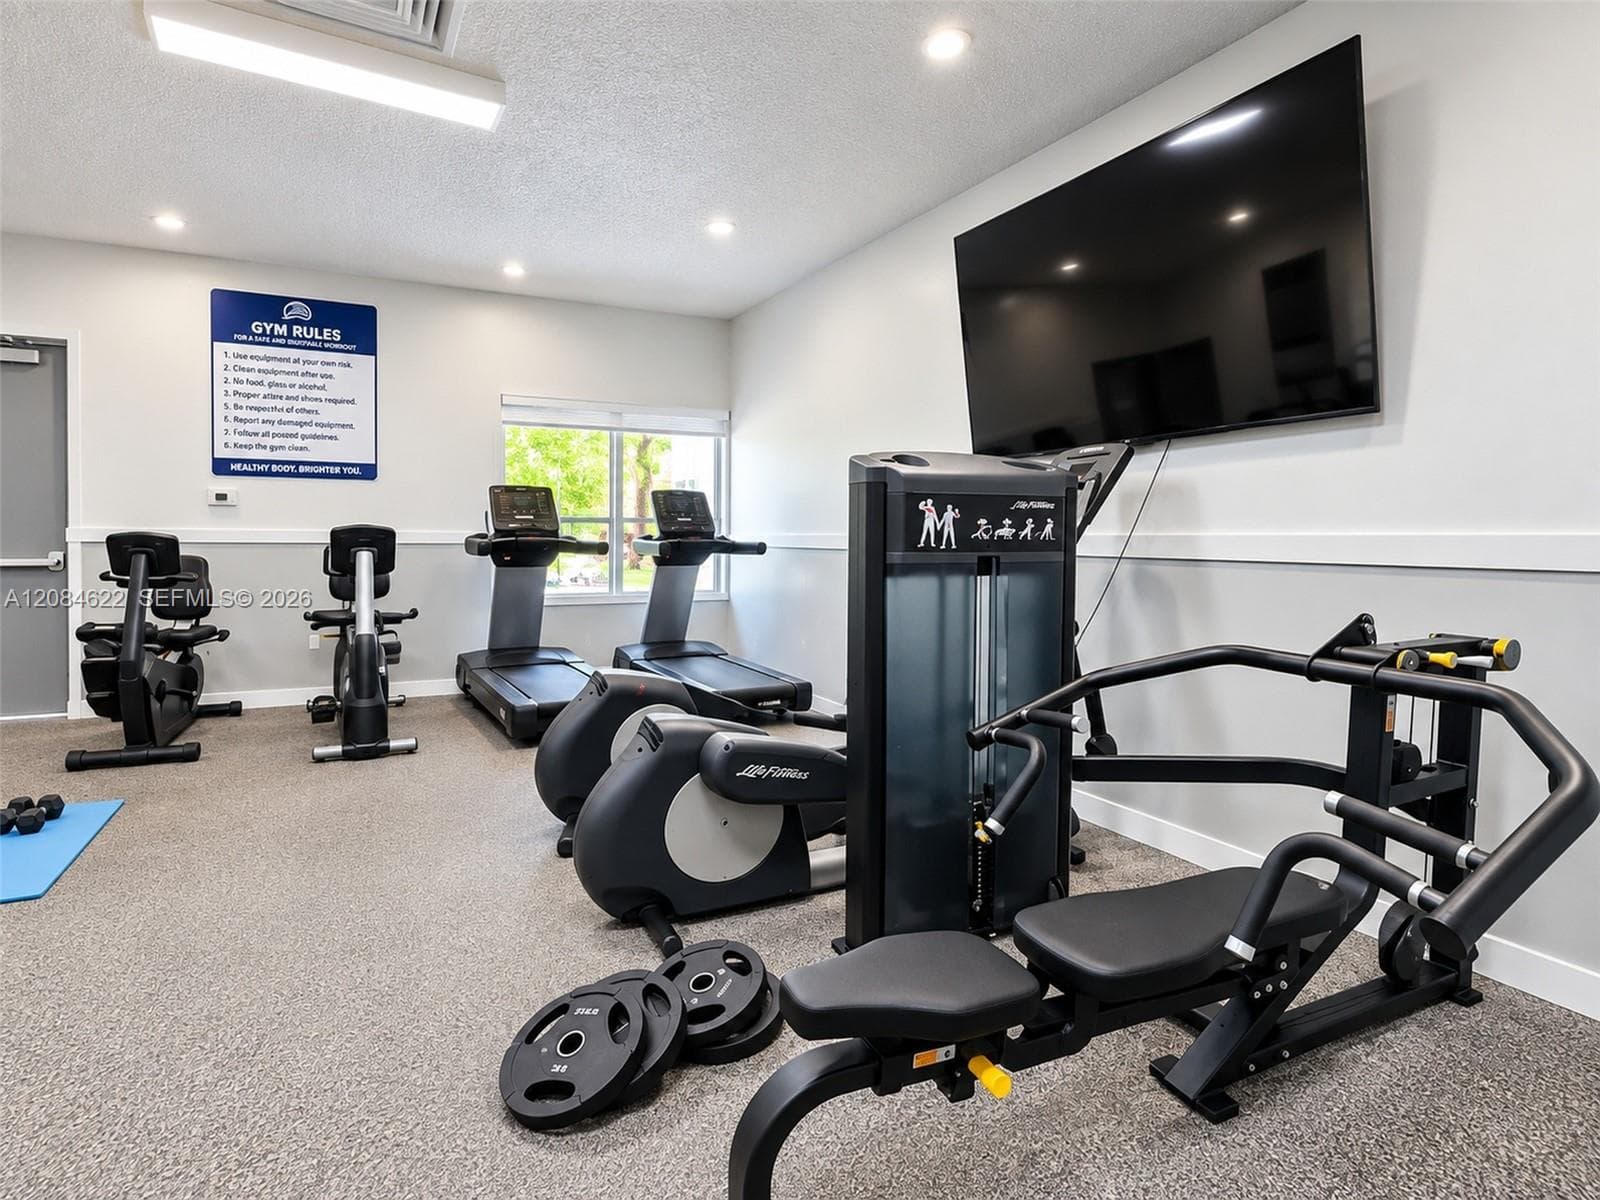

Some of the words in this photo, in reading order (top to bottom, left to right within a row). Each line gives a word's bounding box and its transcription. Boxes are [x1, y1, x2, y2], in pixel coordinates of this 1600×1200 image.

[251, 321, 288, 337] GYM
[292, 325, 341, 341] RULES
[224, 351, 231, 359] 1.
[232, 352, 249, 360] Use
[249, 354, 291, 363] equipment
[292, 357, 301, 365] at
[301, 359, 319, 367] your
[337, 361, 353, 369] risk.
[223, 363, 231, 372] 2.
[232, 364, 256, 373] Clean
[300, 370, 319, 378] after
[233, 377, 245, 385] No
[232, 390, 261, 400] Proper
[284, 394, 300, 402] and
[324, 397, 358, 406] required.
[233, 402, 244, 411] Be
[285, 405, 295, 414] of
[233, 415, 260, 426] Report
[261, 418, 276, 427] any
[276, 418, 314, 429] damaged
[314, 420, 356, 430] equipment.
[260, 430, 271, 438] all
[300, 432, 340, 442] guidelines.
[233, 442, 254, 451] Keep
[254, 442, 268, 450] the
[268, 444, 287, 453] gym
[230, 463, 270, 473] HEALTHY
[298, 465, 341, 475] BRIGHTER
[342, 466, 363, 476] YOU.
